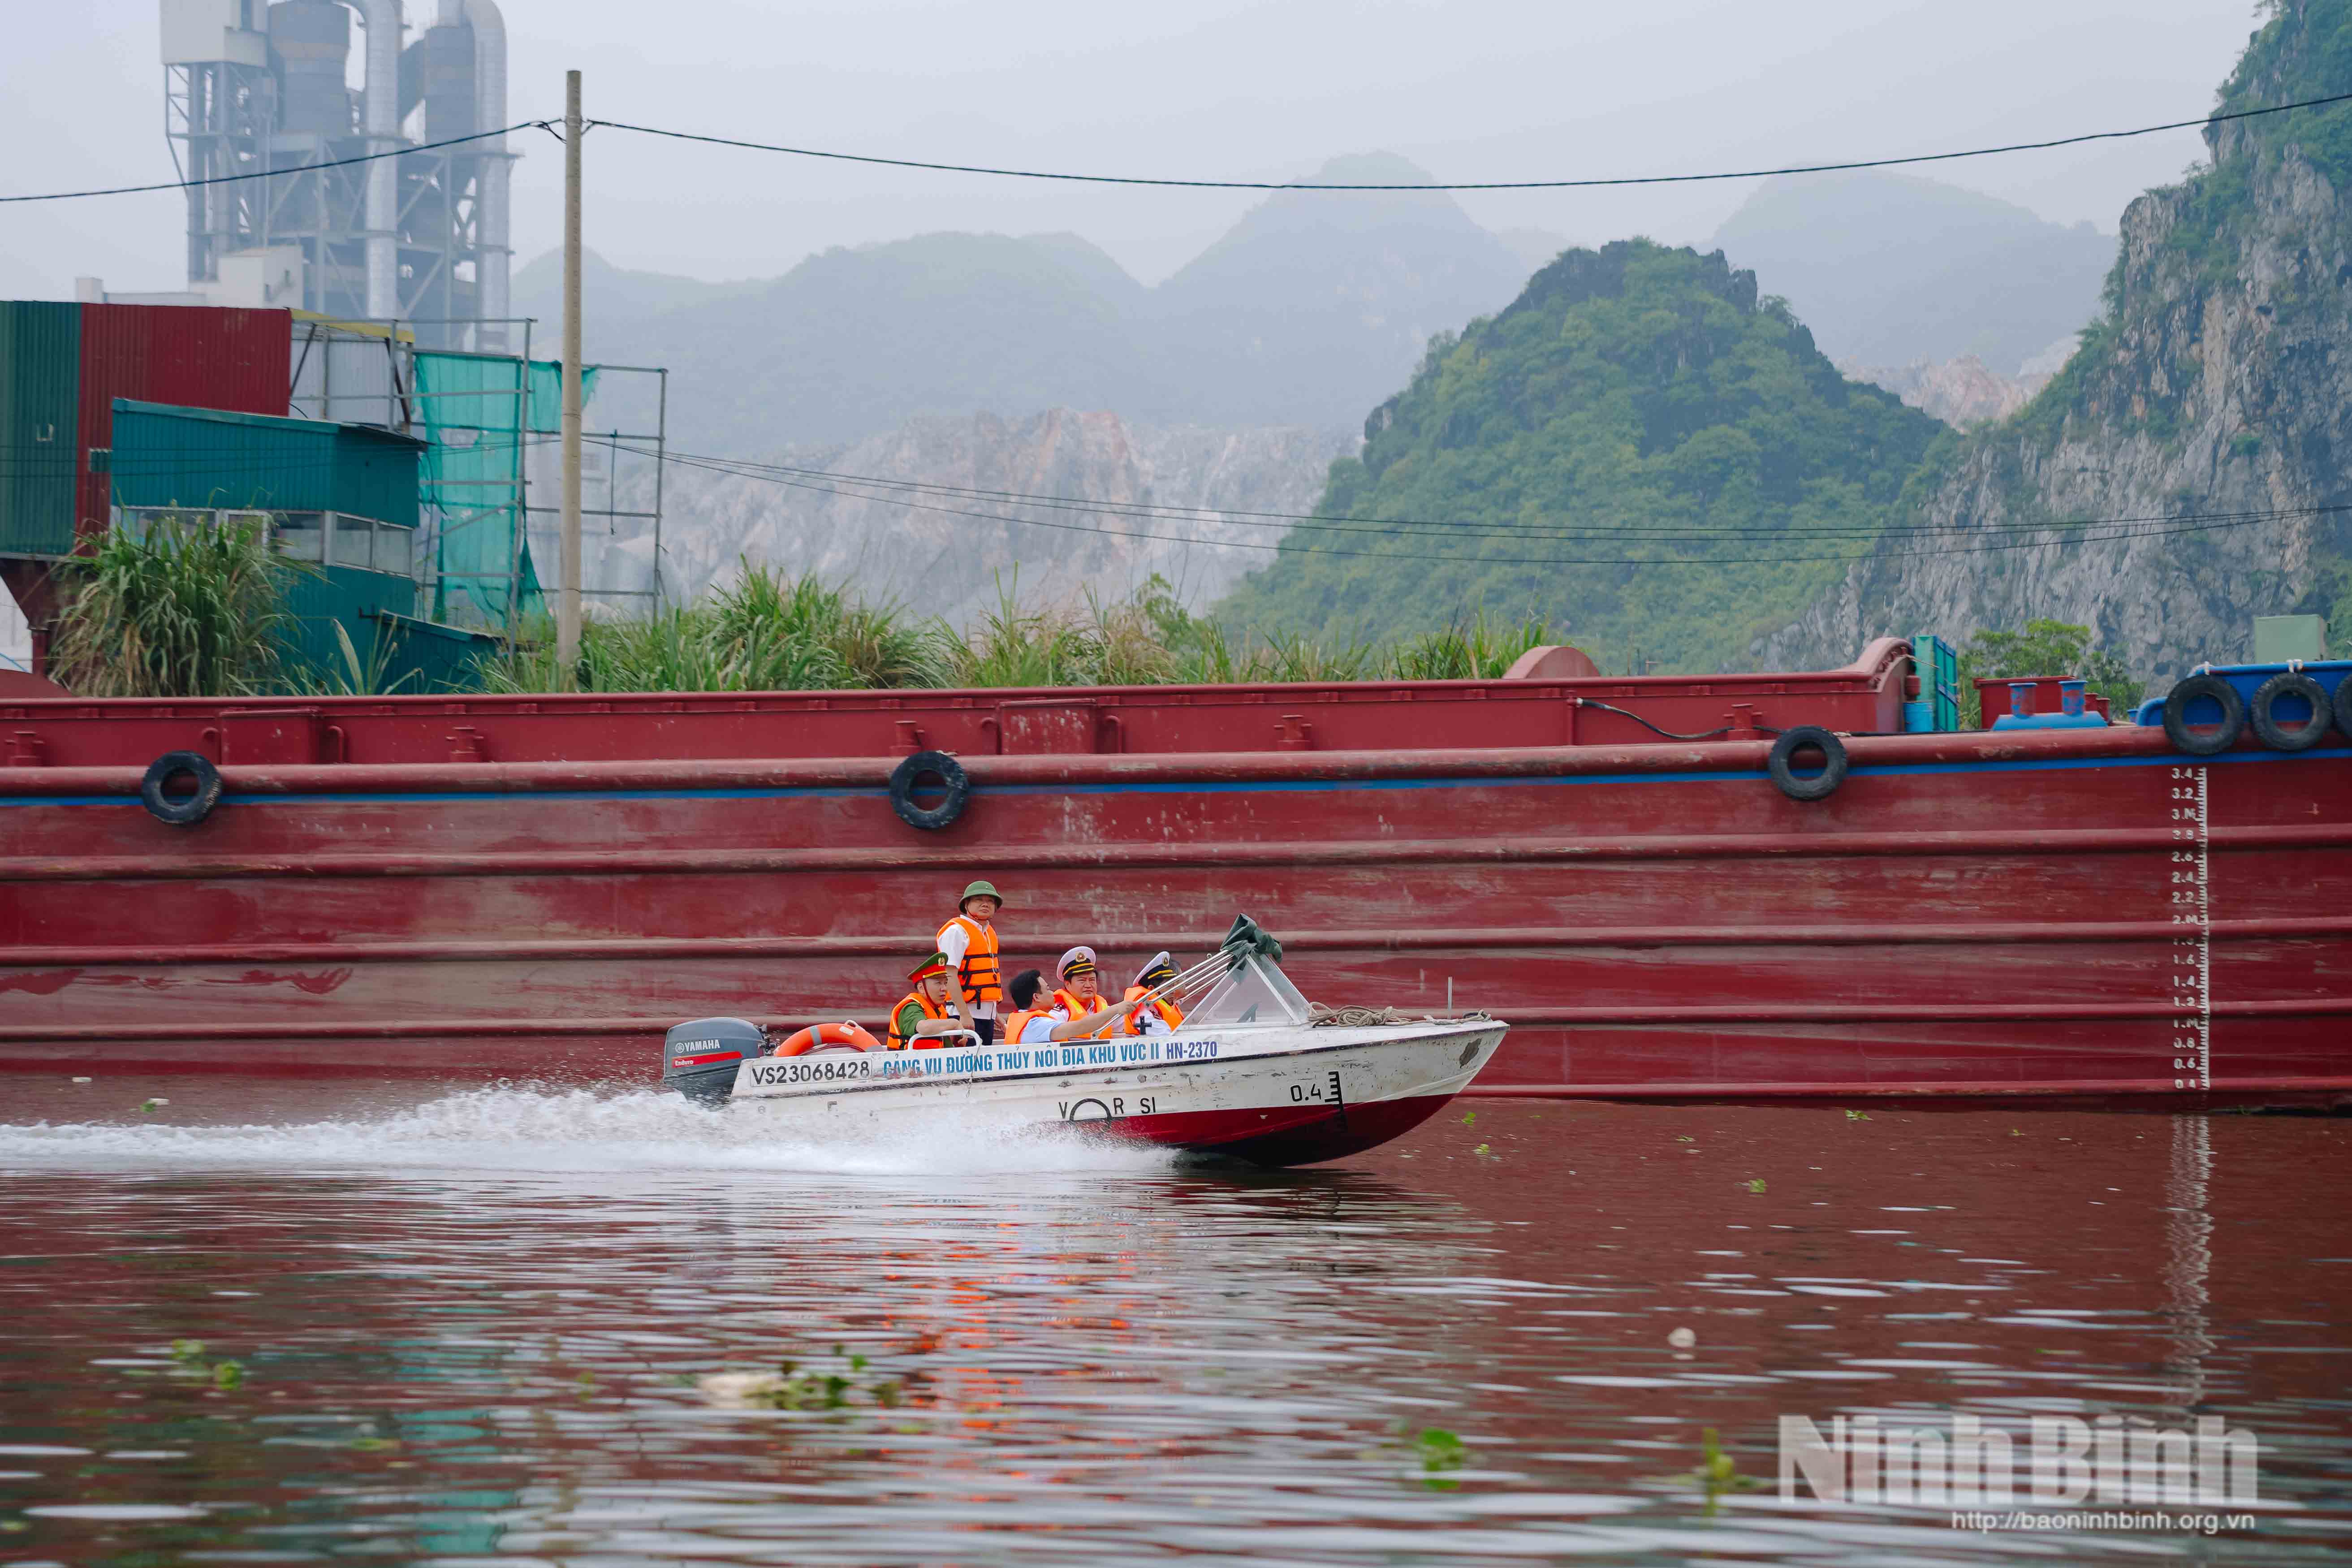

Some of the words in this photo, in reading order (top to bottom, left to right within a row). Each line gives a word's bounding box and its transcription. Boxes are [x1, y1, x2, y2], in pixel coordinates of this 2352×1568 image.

[2172, 767, 2192, 779] 3.4
[2172, 787, 2193, 799] 3.2
[2172, 851, 2193, 862] 2.6
[2172, 872, 2193, 883] 2.4
[2172, 891, 2194, 903] 2.2
[2174, 954, 2194, 964] 1.6
[2174, 976, 2195, 986] 1.4
[2174, 997, 2195, 1006] 1.2
[684, 1040, 721, 1052] YAMAHA
[946, 1050, 993, 1073] ĐƯỜNG
[996, 1046, 1030, 1070] THỦY
[1062, 1047, 1085, 1068] ĐỊA
[1089, 1045, 1116, 1064] KHU
[1120, 1042, 1146, 1064] VỰC
[1151, 1043, 1159, 1059] II
[1166, 1041, 1217, 1060] HN-2370
[2174, 1057, 2196, 1069] 0.6
[752, 1061, 870, 1085] VS23068428
[1290, 1083, 1321, 1102] 0.4
[1058, 1101, 1068, 1119] V
[1113, 1097, 1124, 1114] R
